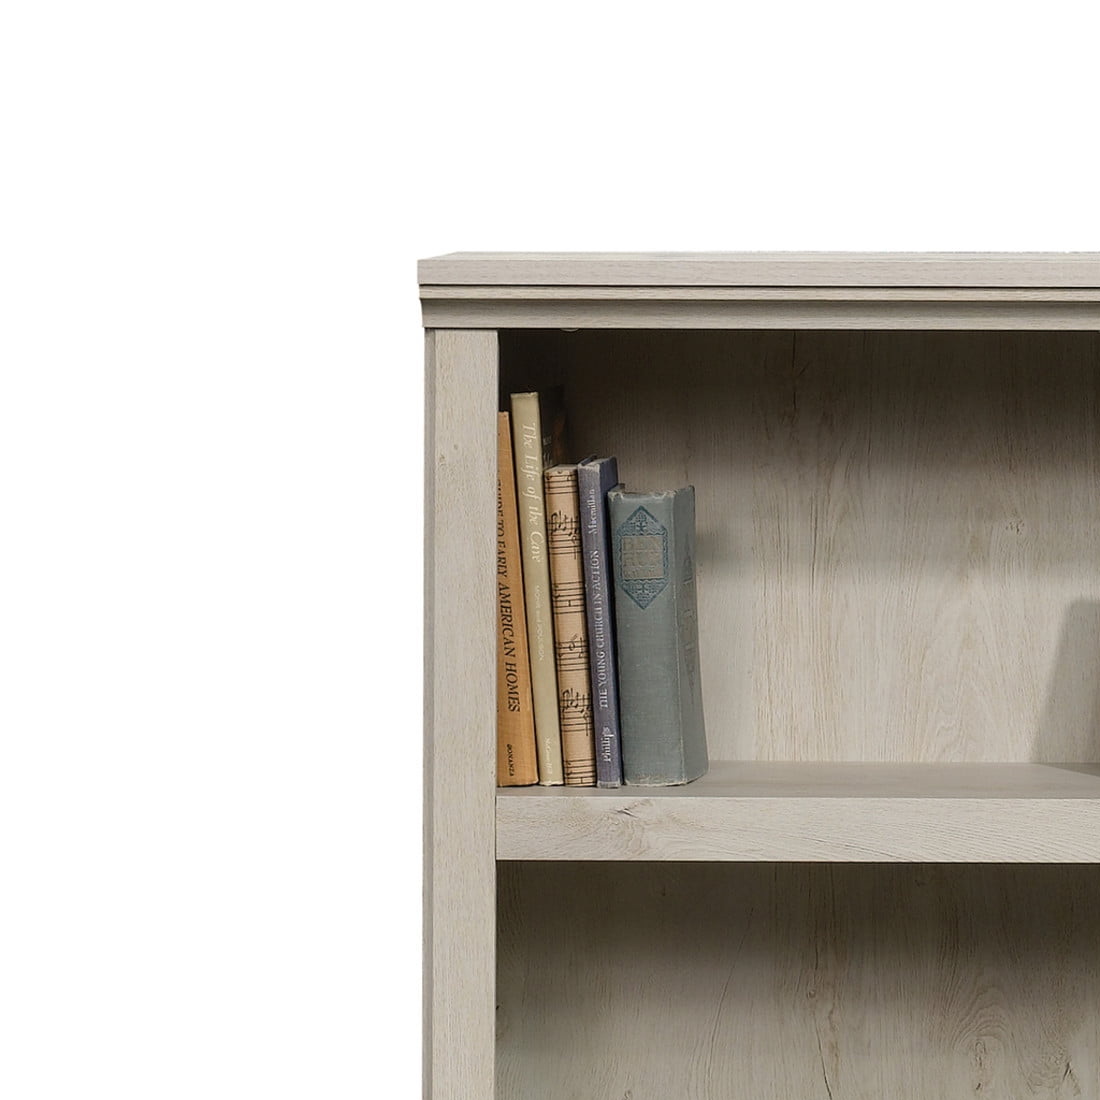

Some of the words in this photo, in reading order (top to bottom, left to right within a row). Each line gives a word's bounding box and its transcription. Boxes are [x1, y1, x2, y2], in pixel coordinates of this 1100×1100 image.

[522, 422, 537, 449] The
[521, 454, 540, 480] Life
[522, 486, 541, 499] of
[528, 505, 542, 525] the
[498, 541, 507, 577] EARLY
[590, 550, 600, 591] ACTION
[592, 593, 602, 604] IN
[498, 582, 516, 657] AMERICAN
[594, 607, 604, 648] CHURCH
[505, 662, 520, 712] HOMES
[596, 651, 606, 687] YOUNG
[599, 688, 609, 708] THE
[600, 726, 614, 762] Phillips
